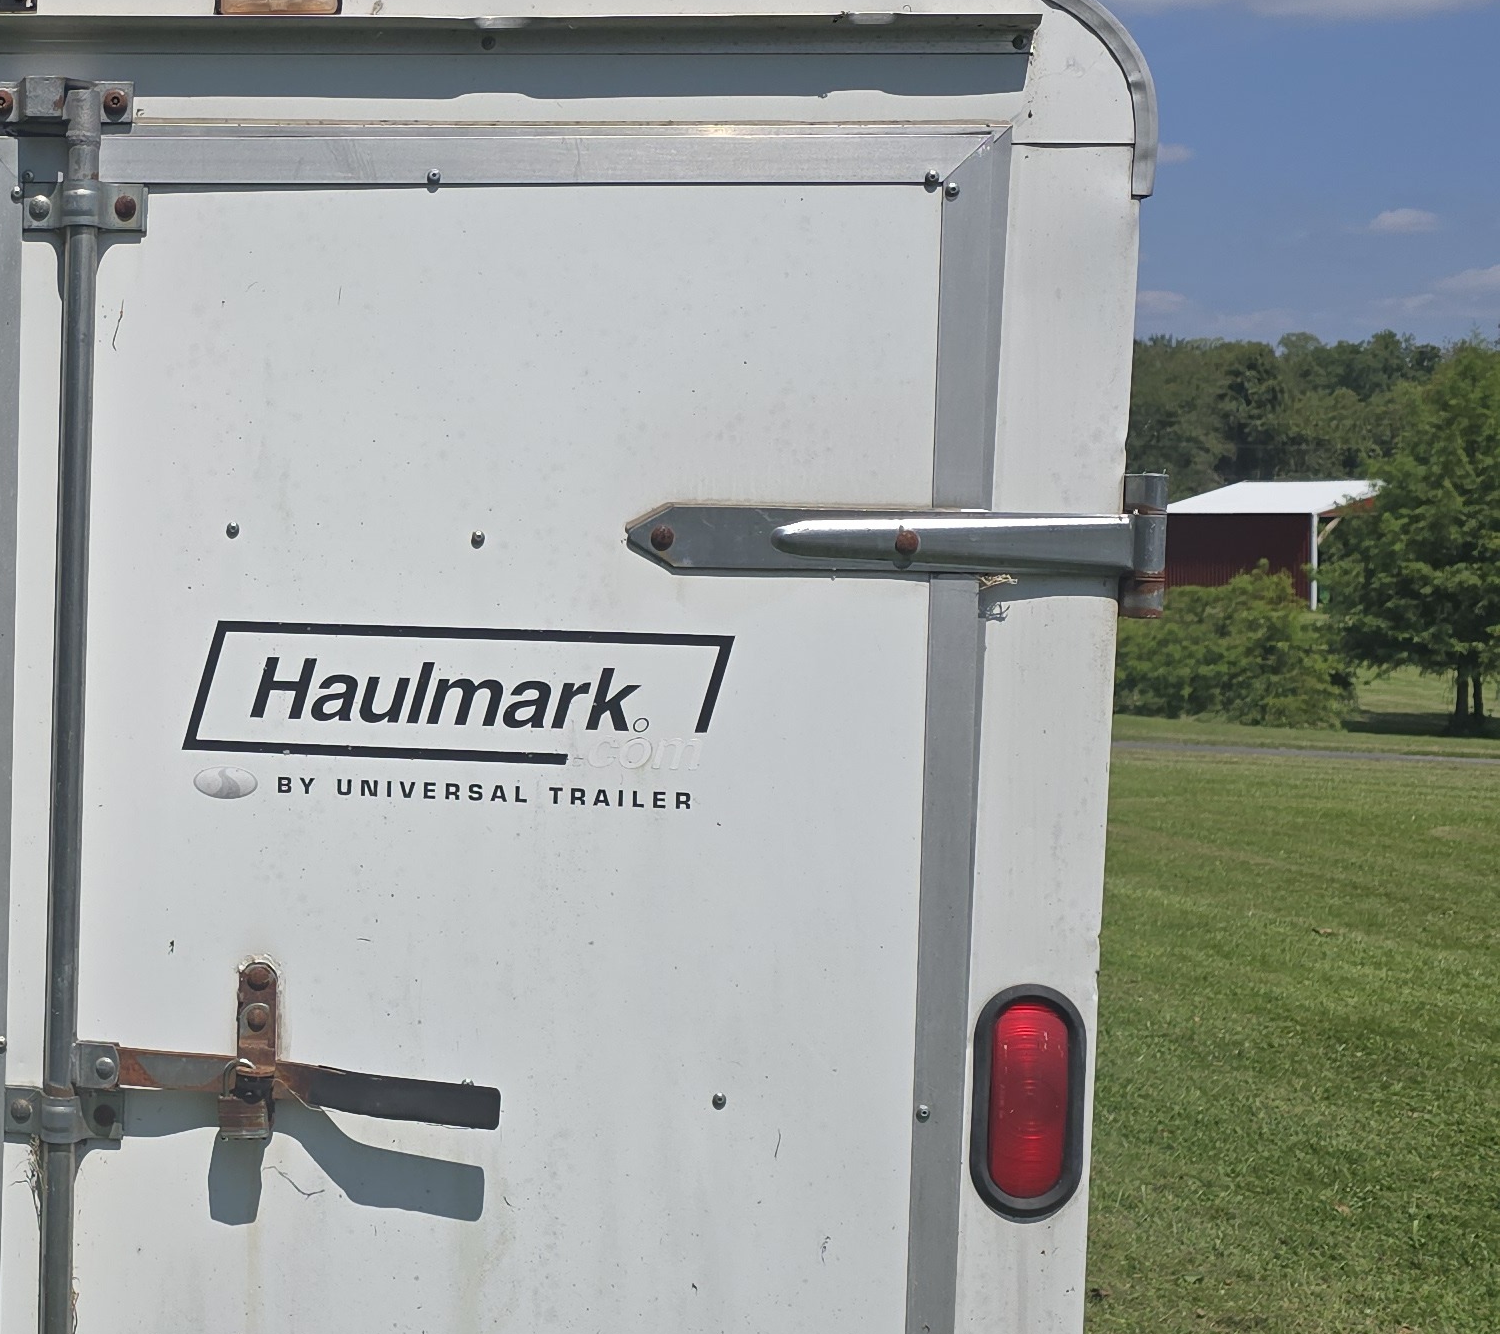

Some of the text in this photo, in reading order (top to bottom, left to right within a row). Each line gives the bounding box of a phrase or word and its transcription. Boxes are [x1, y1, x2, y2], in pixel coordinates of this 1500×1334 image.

[249, 656, 642, 732] Haulmark
[277, 776, 692, 811] BY UNIVERSAL TRAILER
